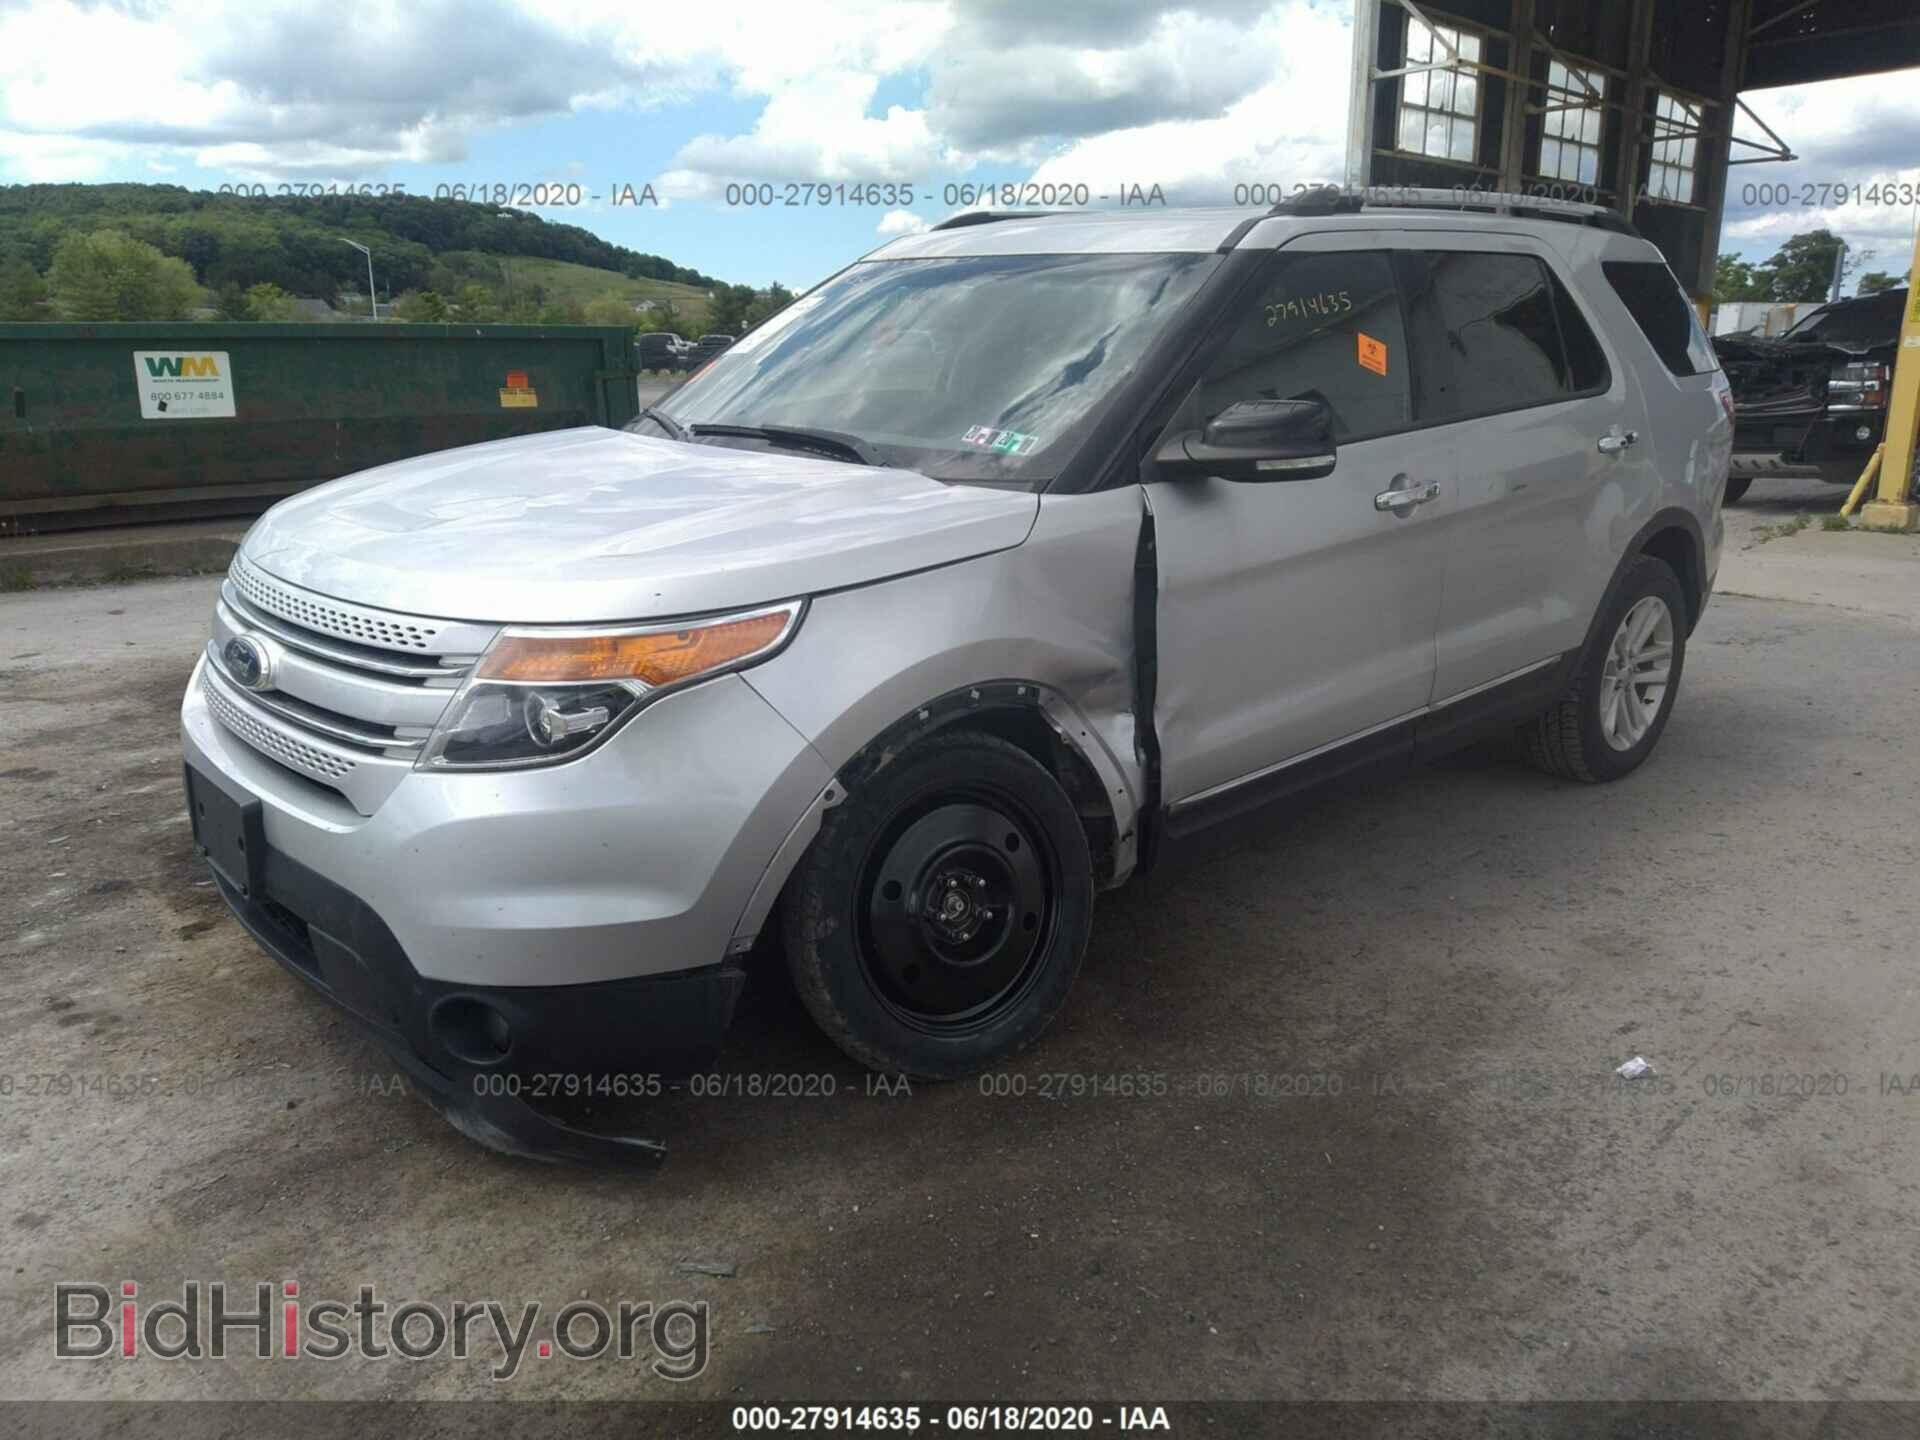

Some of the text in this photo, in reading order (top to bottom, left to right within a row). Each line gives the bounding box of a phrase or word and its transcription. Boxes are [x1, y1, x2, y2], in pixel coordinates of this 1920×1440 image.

[144, 356, 219, 377] WM
[151, 391, 171, 401] 800
[174, 391, 194, 401] 677
